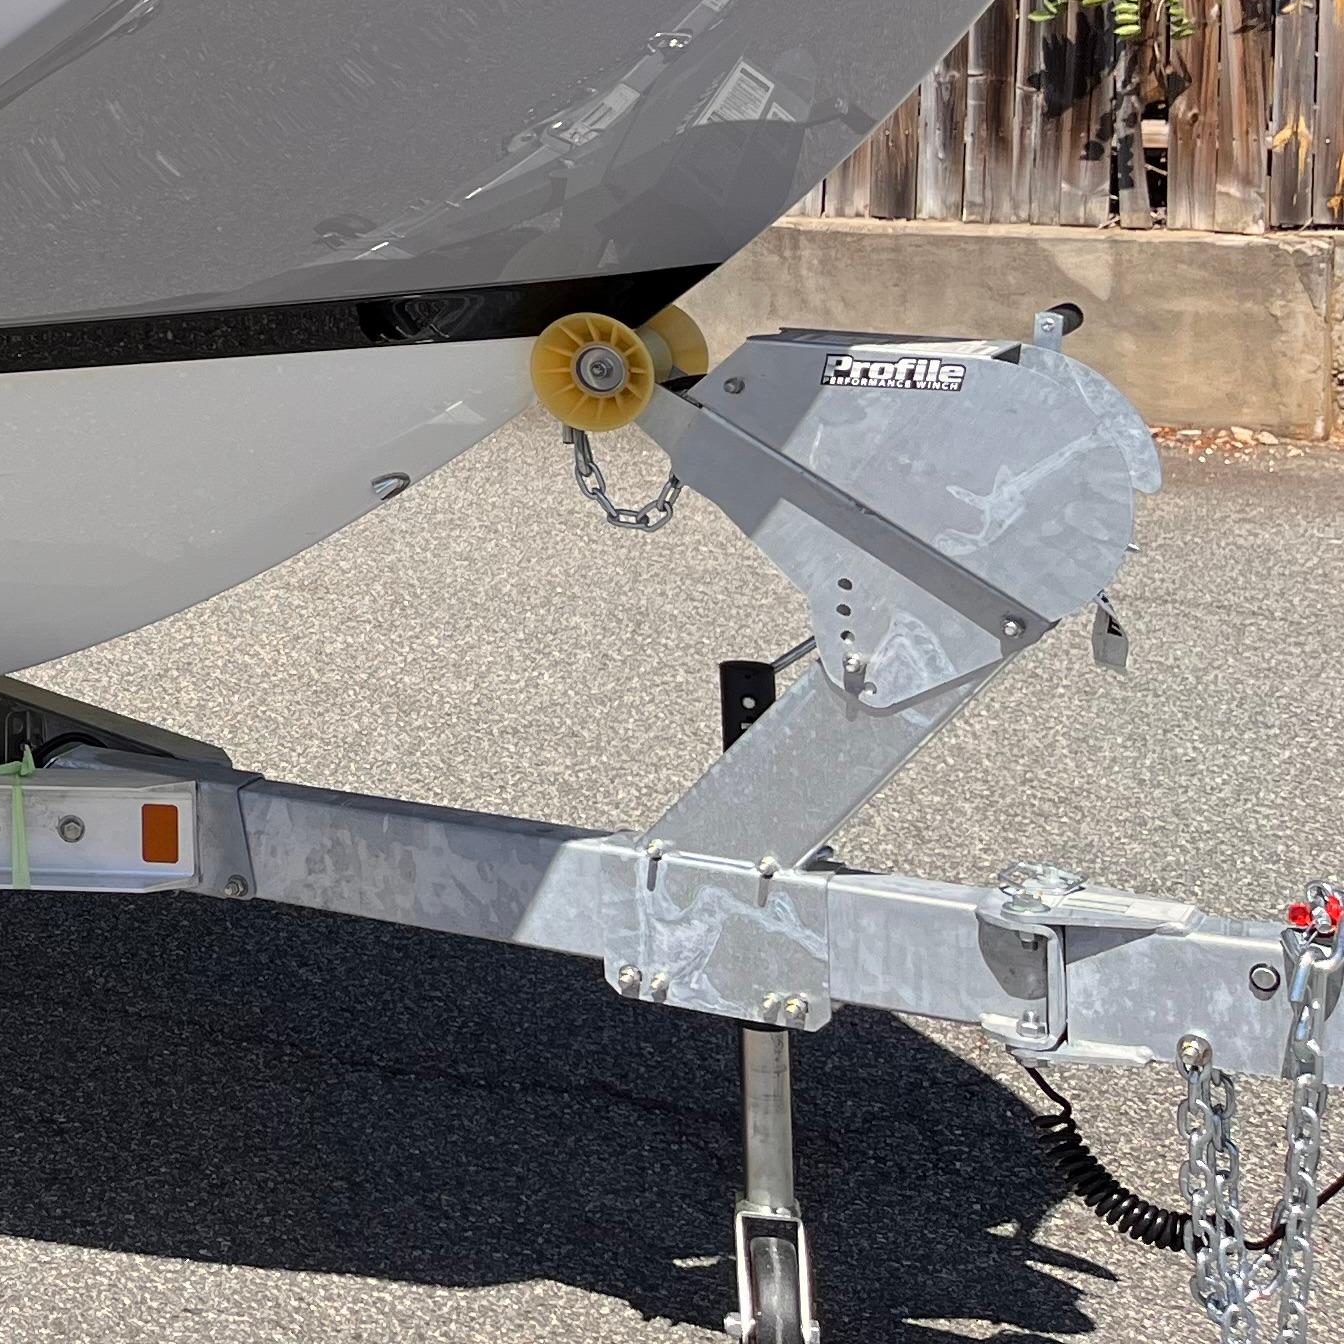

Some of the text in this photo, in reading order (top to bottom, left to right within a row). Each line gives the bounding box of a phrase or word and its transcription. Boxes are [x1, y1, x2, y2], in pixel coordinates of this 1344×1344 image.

[823, 355, 966, 383] Profile
[822, 375, 960, 391] PERFORMANCE WINCH
